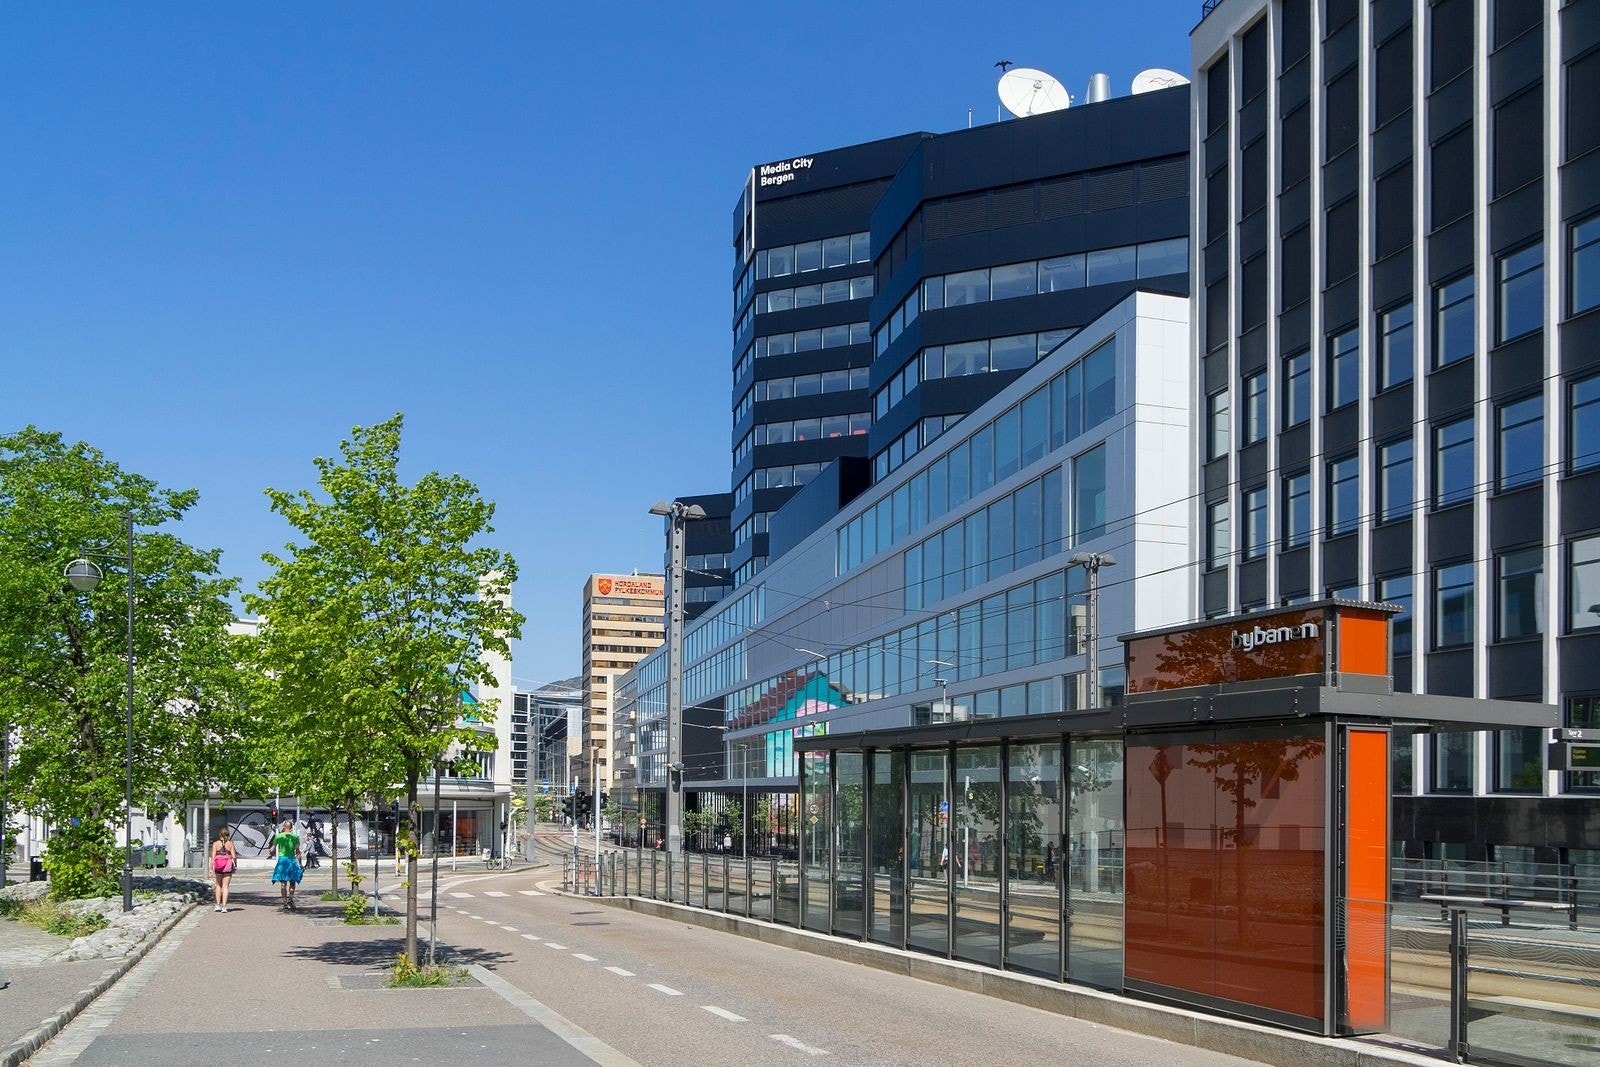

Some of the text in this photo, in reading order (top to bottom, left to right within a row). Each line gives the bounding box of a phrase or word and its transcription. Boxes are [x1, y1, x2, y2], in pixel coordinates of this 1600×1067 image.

[760, 158, 814, 176] Media City
[760, 172, 795, 186] Bergen
[1231, 622, 1319, 652] bybanen
[1577, 730, 1583, 738] 2
